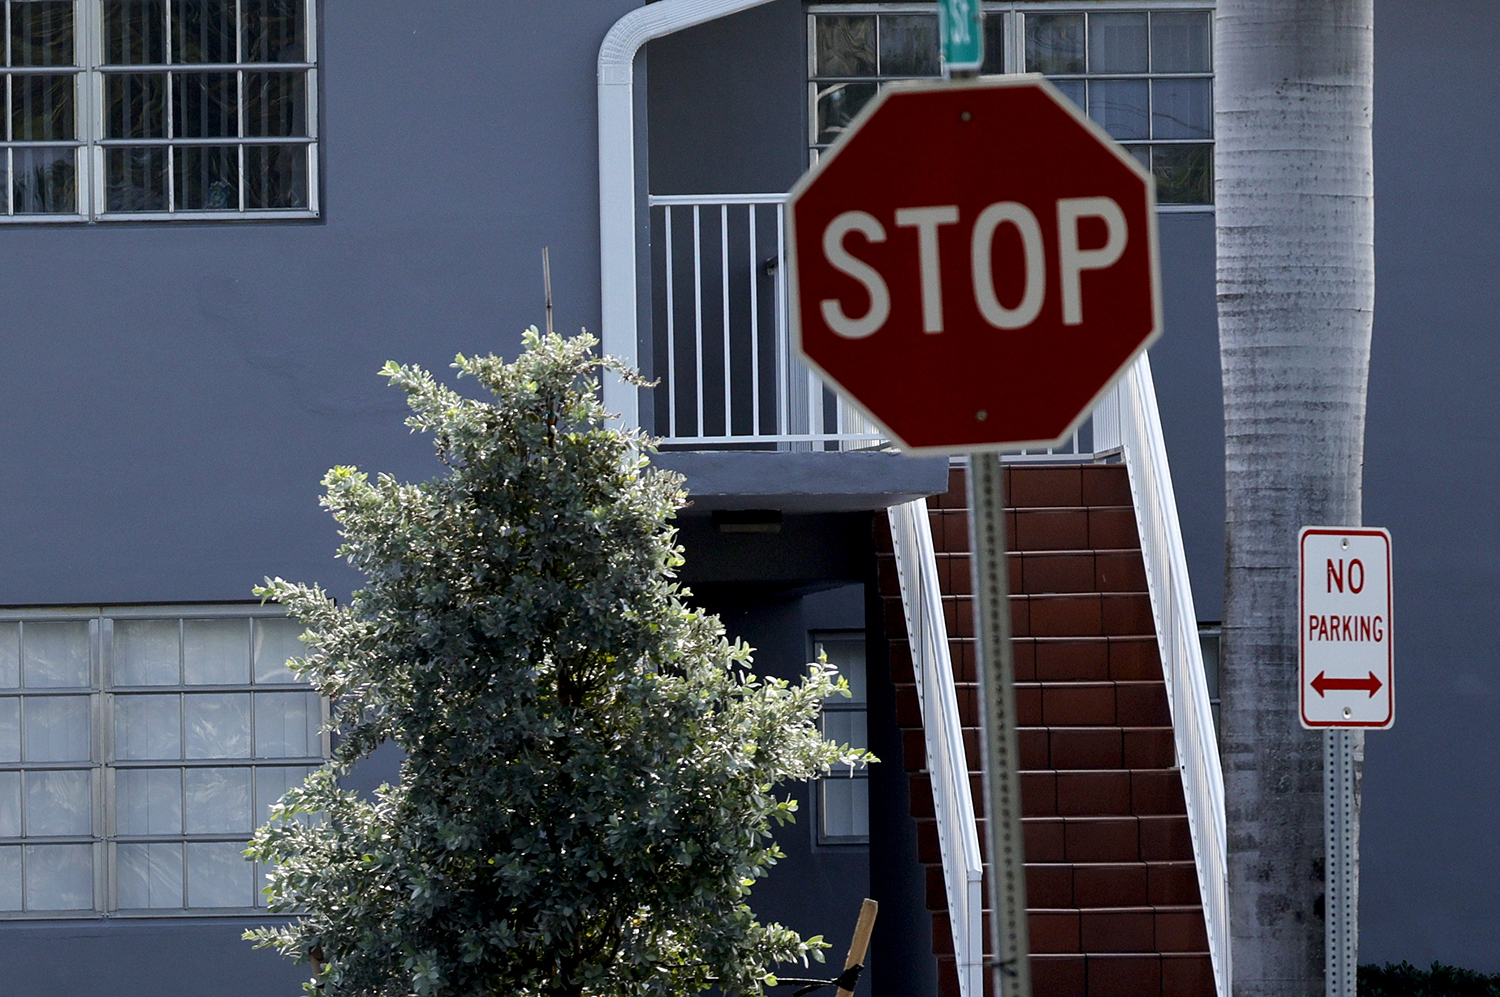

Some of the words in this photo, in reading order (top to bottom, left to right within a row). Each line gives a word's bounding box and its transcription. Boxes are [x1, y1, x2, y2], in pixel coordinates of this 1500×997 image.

[820, 196, 1129, 340] STOP
[1327, 558, 1365, 595] NO
[1309, 615, 1384, 643] PARKING
